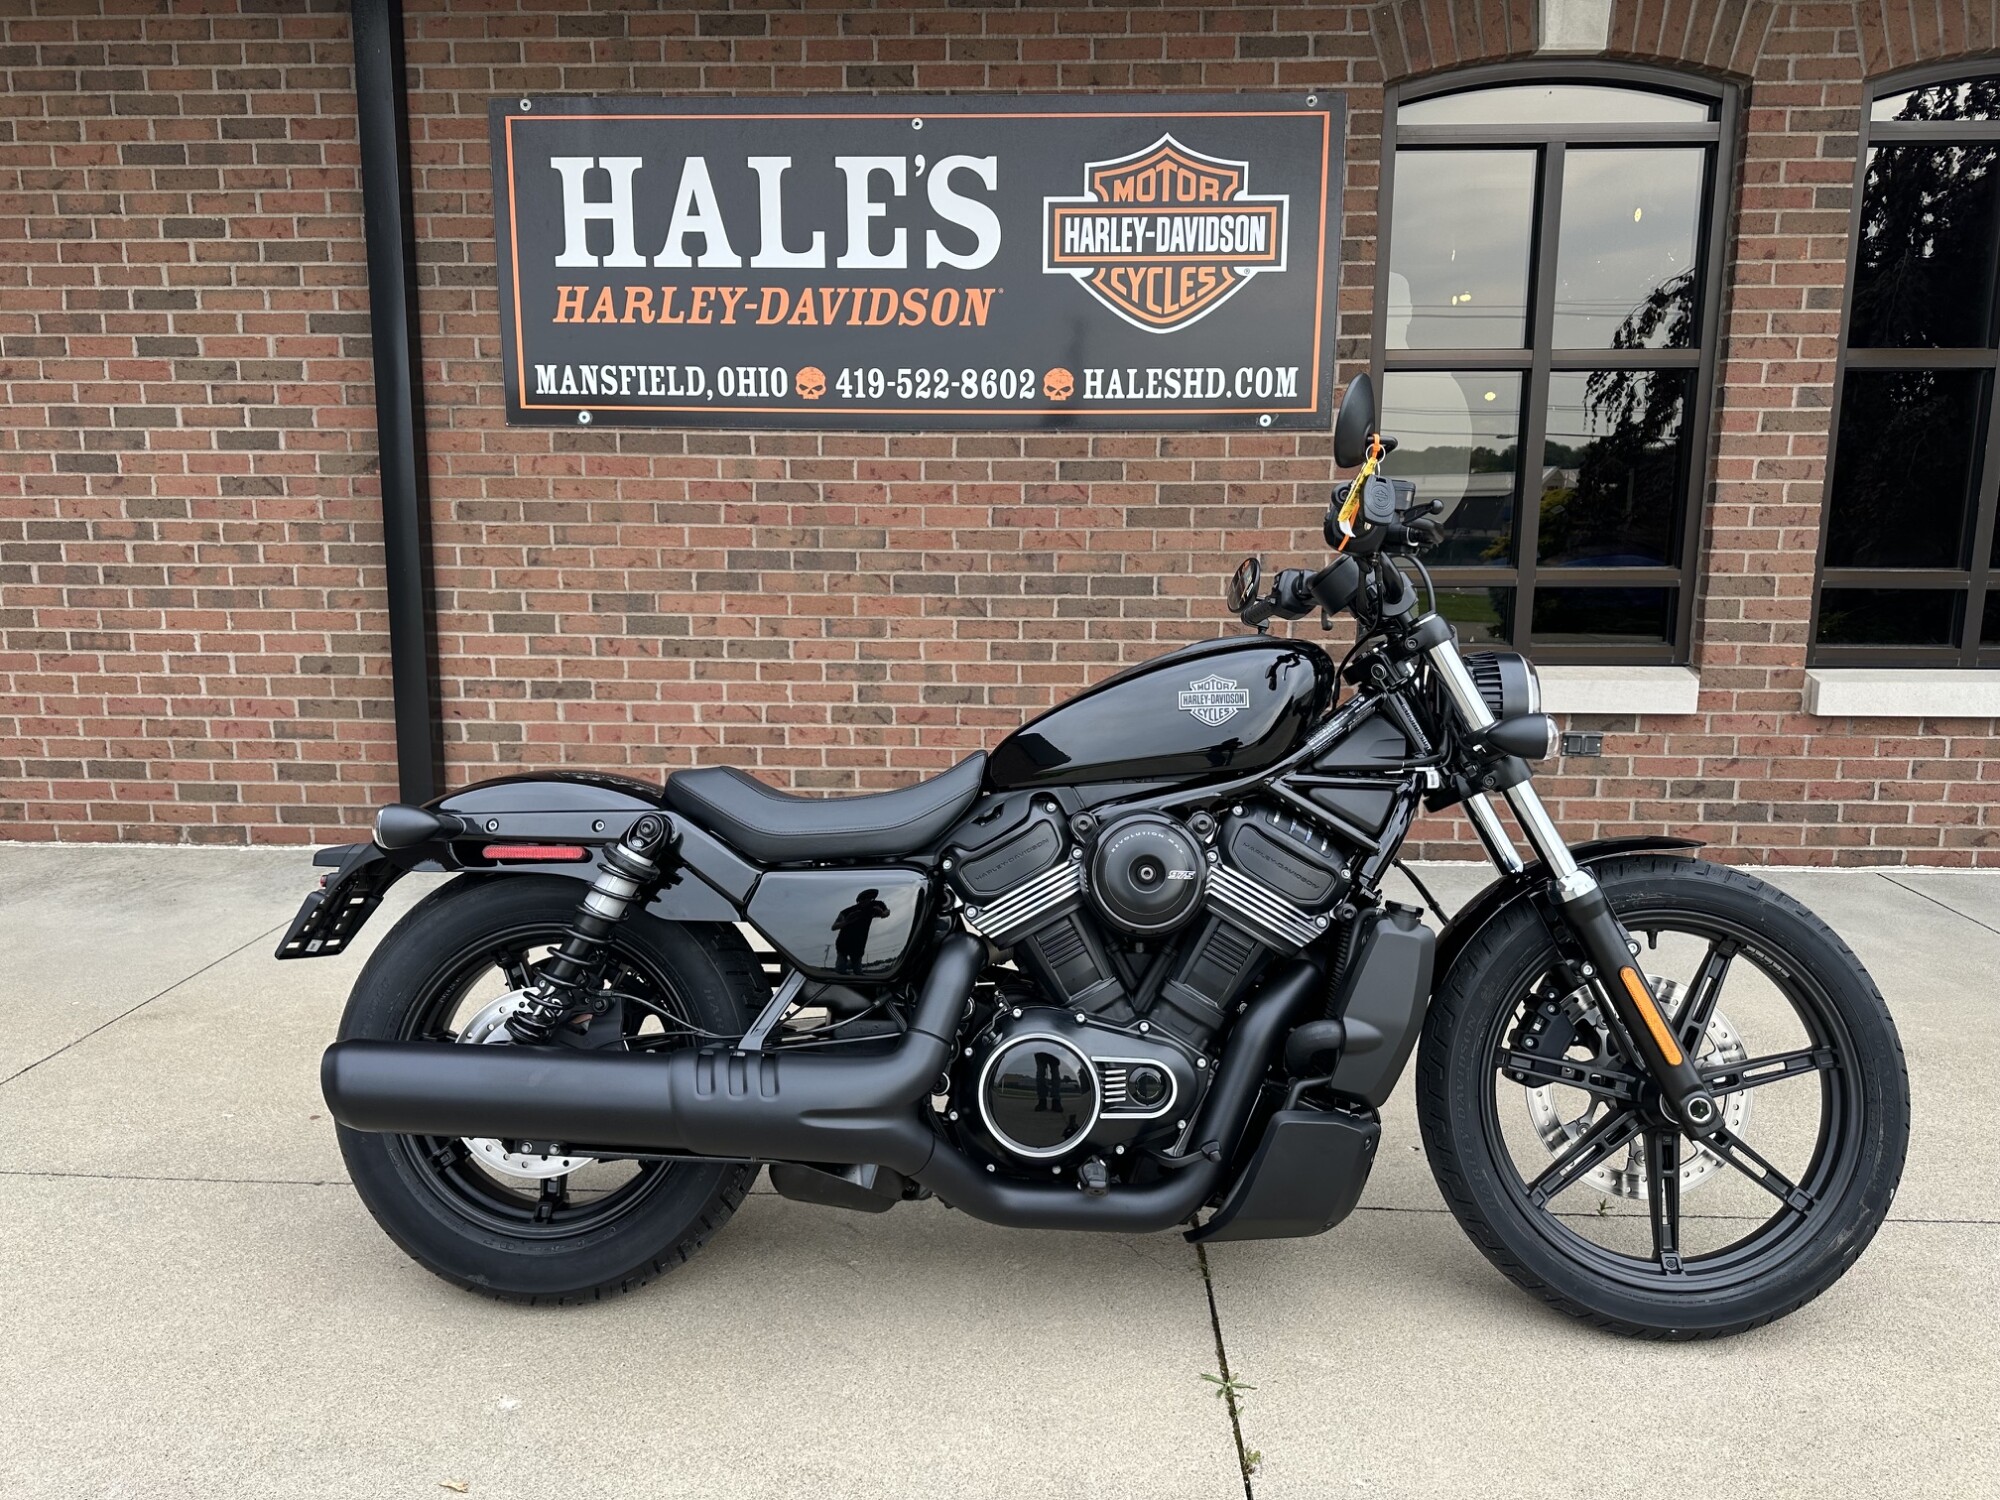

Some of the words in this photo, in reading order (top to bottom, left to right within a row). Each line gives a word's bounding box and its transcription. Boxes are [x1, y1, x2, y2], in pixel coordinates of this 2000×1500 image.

[1113, 160, 1220, 203] MOTOR
[550, 154, 1002, 270] HALE'S
[1064, 214, 1266, 253] HARLEY-DAVIDSON
[552, 285, 996, 327] HARLEY-DAVIDSON
[1110, 266, 1216, 315] CYCLES
[835, 367, 1036, 400] 419-522-8602
[1082, 366, 1299, 399] HALESHD.COM
[1182, 693, 1245, 706] HARLEY-DAVIDSON
[1197, 680, 1230, 691] MOTOR
[1196, 707, 1231, 721] CYCLES
[975, 838, 1050, 881] HARLEY-DAVIDSON
[1111, 831, 1165, 853] REVOLUTION
[1167, 869, 1196, 880] 975
[1242, 842, 1320, 890] HARLEY-DAVIDSON
